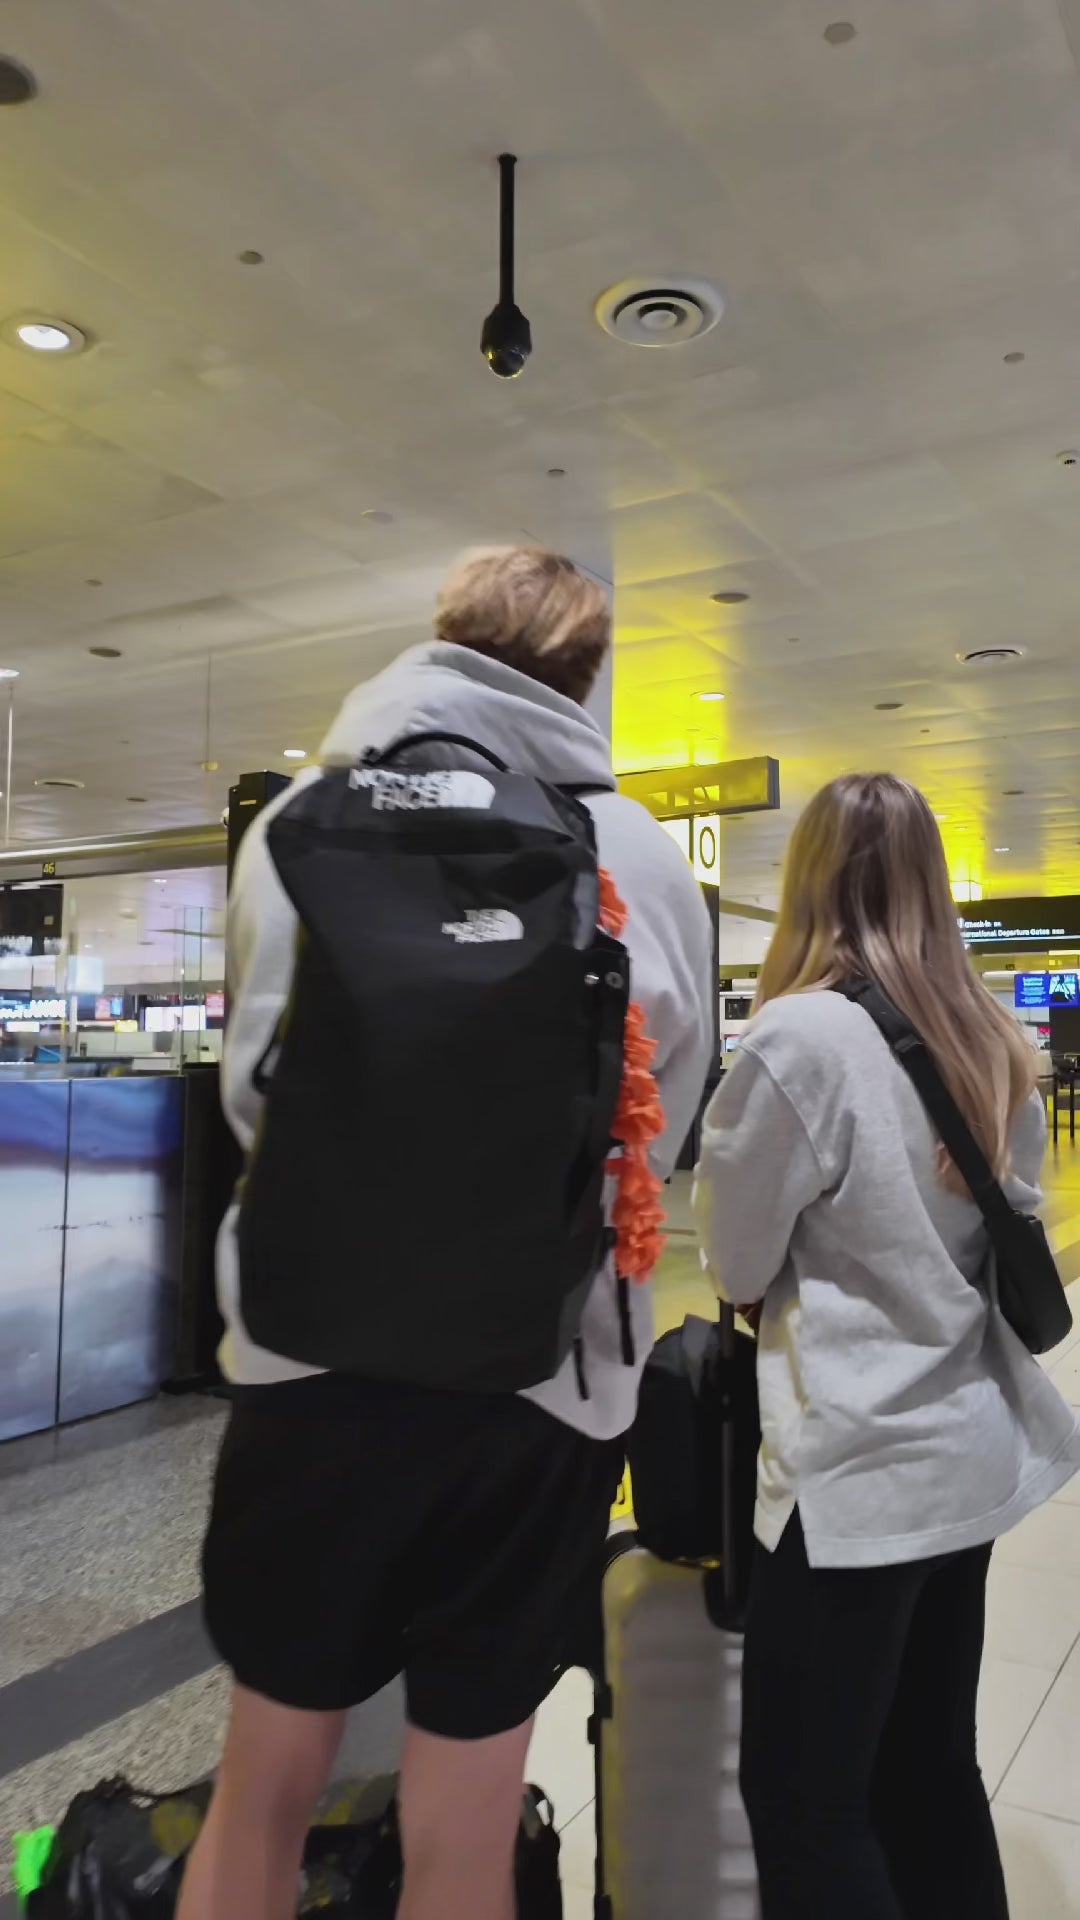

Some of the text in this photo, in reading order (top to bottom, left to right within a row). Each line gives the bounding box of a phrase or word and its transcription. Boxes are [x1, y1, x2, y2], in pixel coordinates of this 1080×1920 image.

[43, 863, 54, 874] 46
[960, 930, 997, 938] nternational
[998, 929, 1030, 938] Departure
[1030, 928, 1050, 936] Gates
